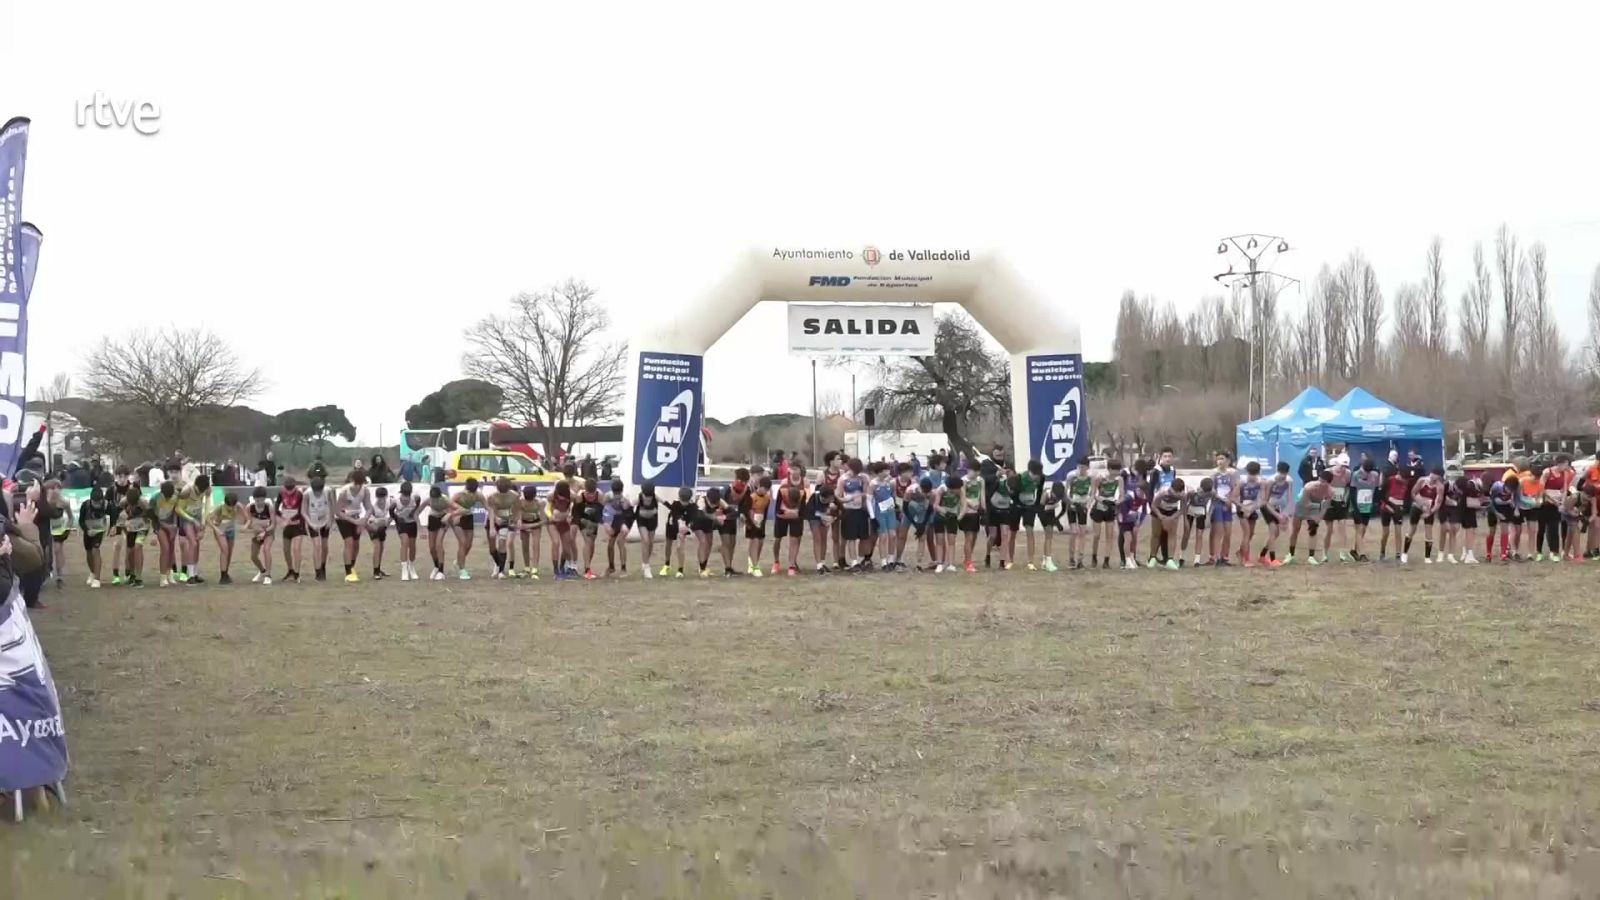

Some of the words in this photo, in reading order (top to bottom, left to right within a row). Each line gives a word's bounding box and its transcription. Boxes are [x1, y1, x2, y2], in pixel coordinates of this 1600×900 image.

[772, 248, 854, 260] Ayuntamiento
[889, 250, 904, 261] de
[908, 250, 971, 261] Valladolid
[809, 276, 851, 287] FMD
[803, 318, 920, 335] SALIDA
[643, 364, 690, 374] Municipal
[656, 406, 681, 463] FMD
[1051, 404, 1074, 459] FMD
